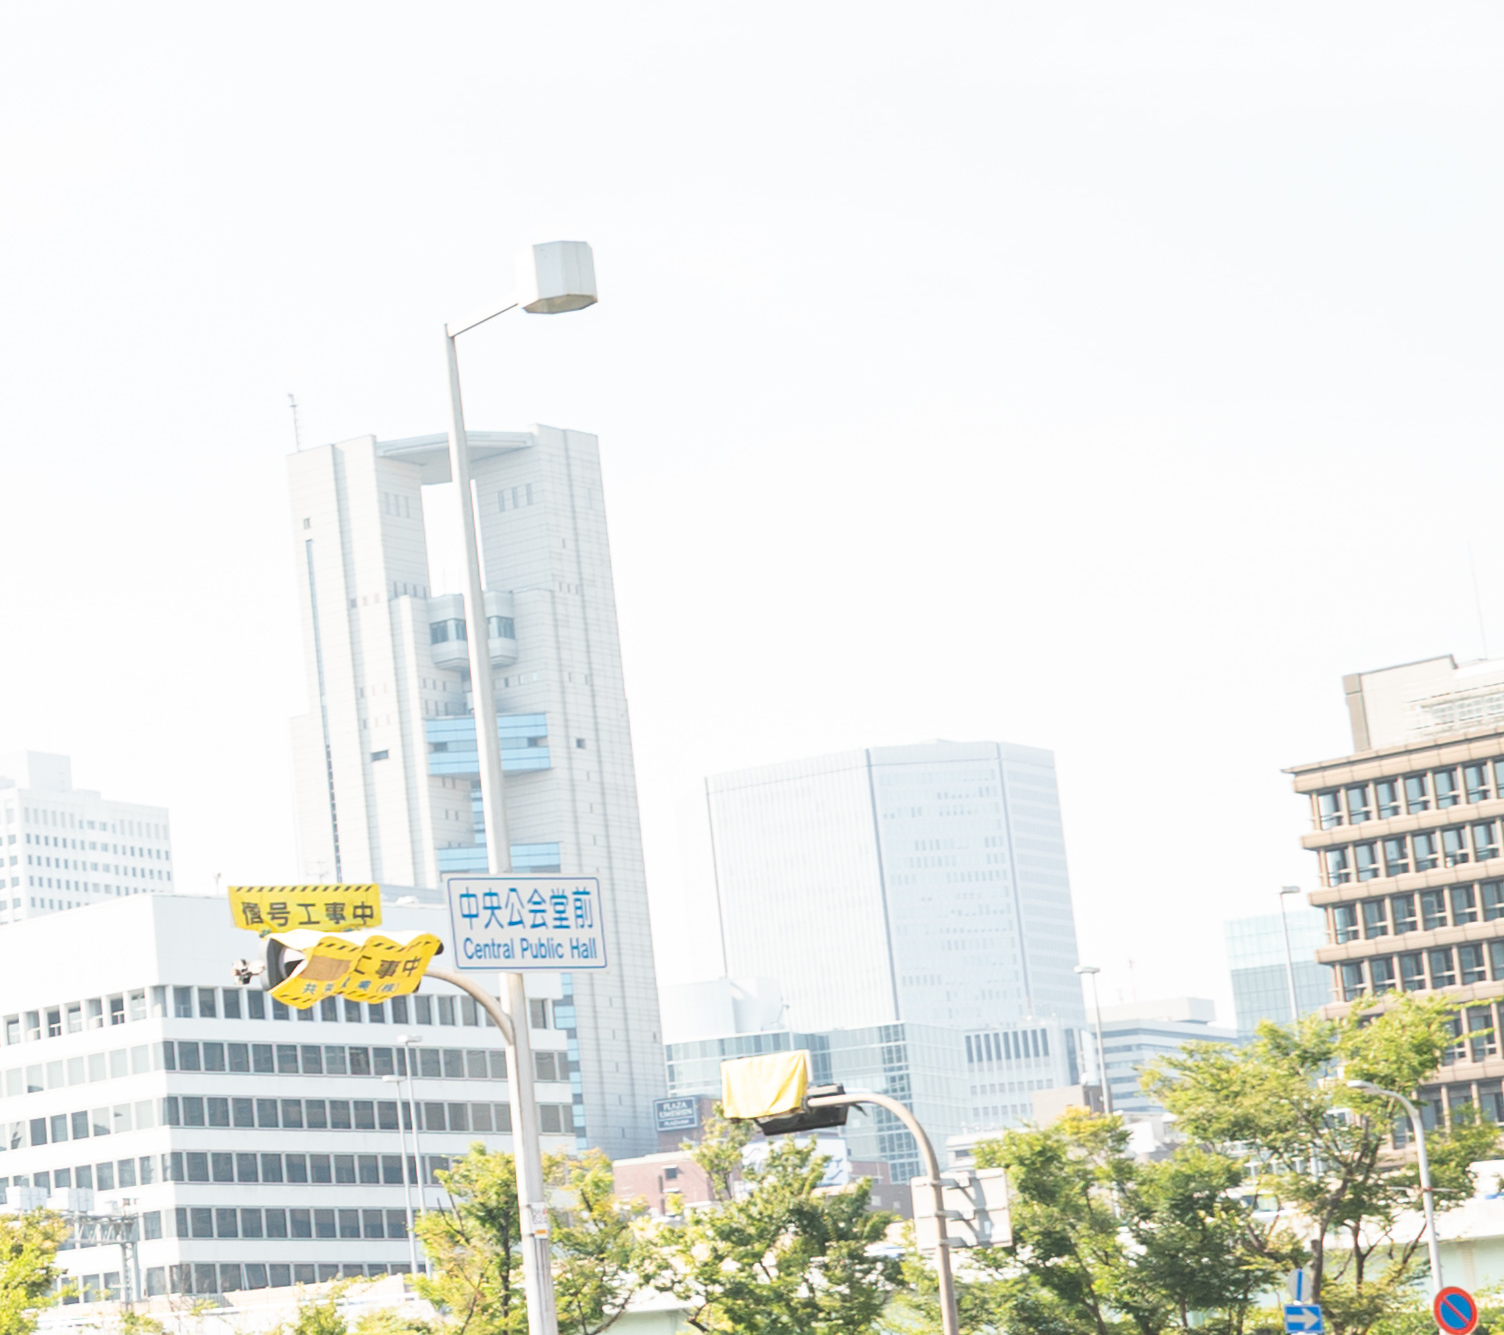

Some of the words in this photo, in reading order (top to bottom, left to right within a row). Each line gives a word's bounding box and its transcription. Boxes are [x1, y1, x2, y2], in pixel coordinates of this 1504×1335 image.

[241, 900, 374, 927] 信号工事中
[459, 886, 593, 930] 中央公会堂前
[463, 937, 515, 960] Central
[520, 937, 564, 959] Public
[569, 937, 598, 959] Hall
